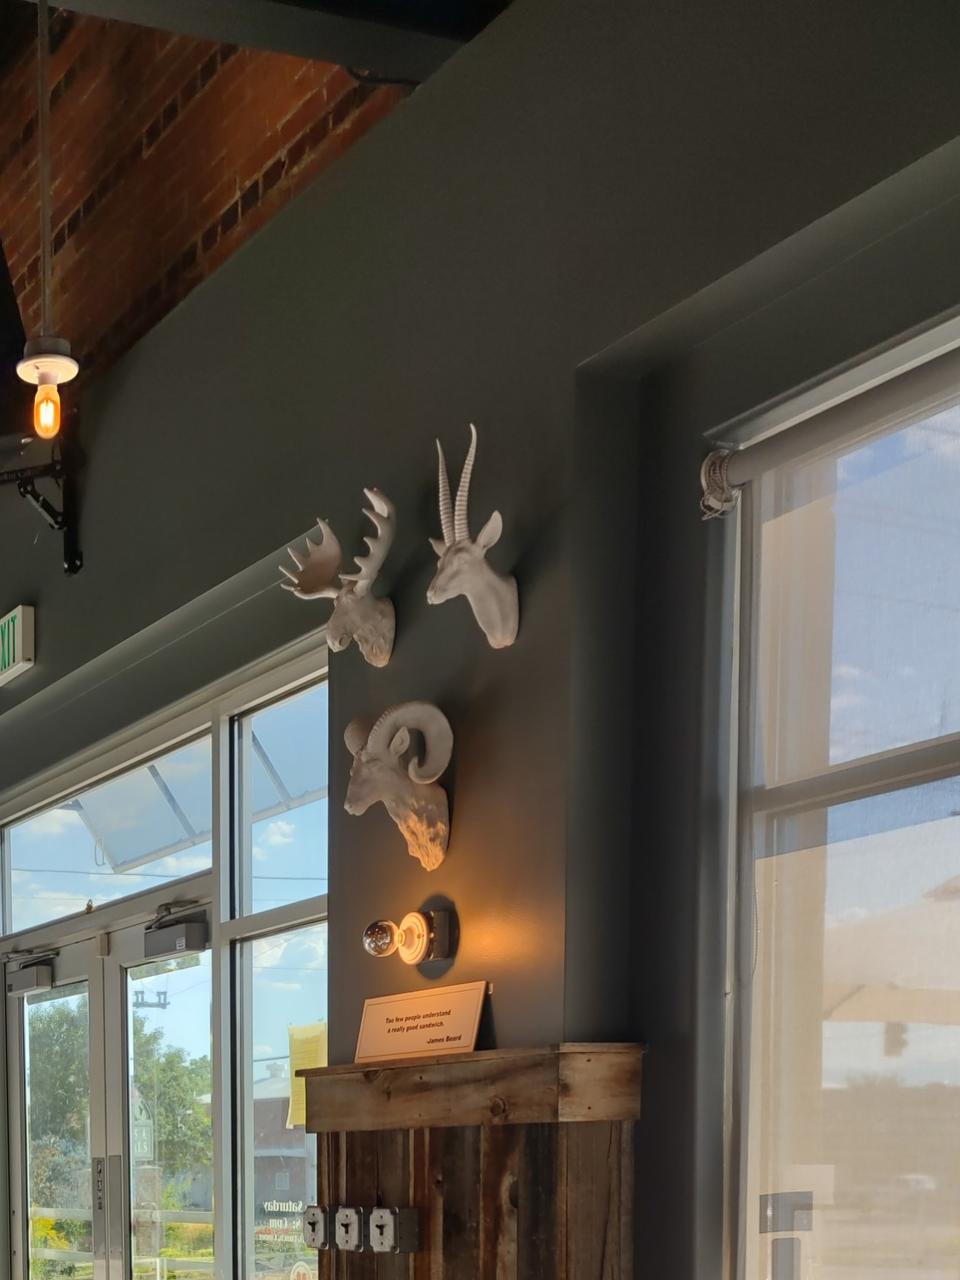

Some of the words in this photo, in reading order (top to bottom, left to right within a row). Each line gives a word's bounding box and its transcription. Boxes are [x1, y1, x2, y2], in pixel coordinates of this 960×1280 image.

[404, 1014, 421, 1023] people
[422, 1009, 452, 1019] understand
[391, 1026, 405, 1034] really
[406, 1024, 419, 1033] good
[419, 1021, 445, 1030] sandwich.
[445, 1034, 462, 1042] Beard
